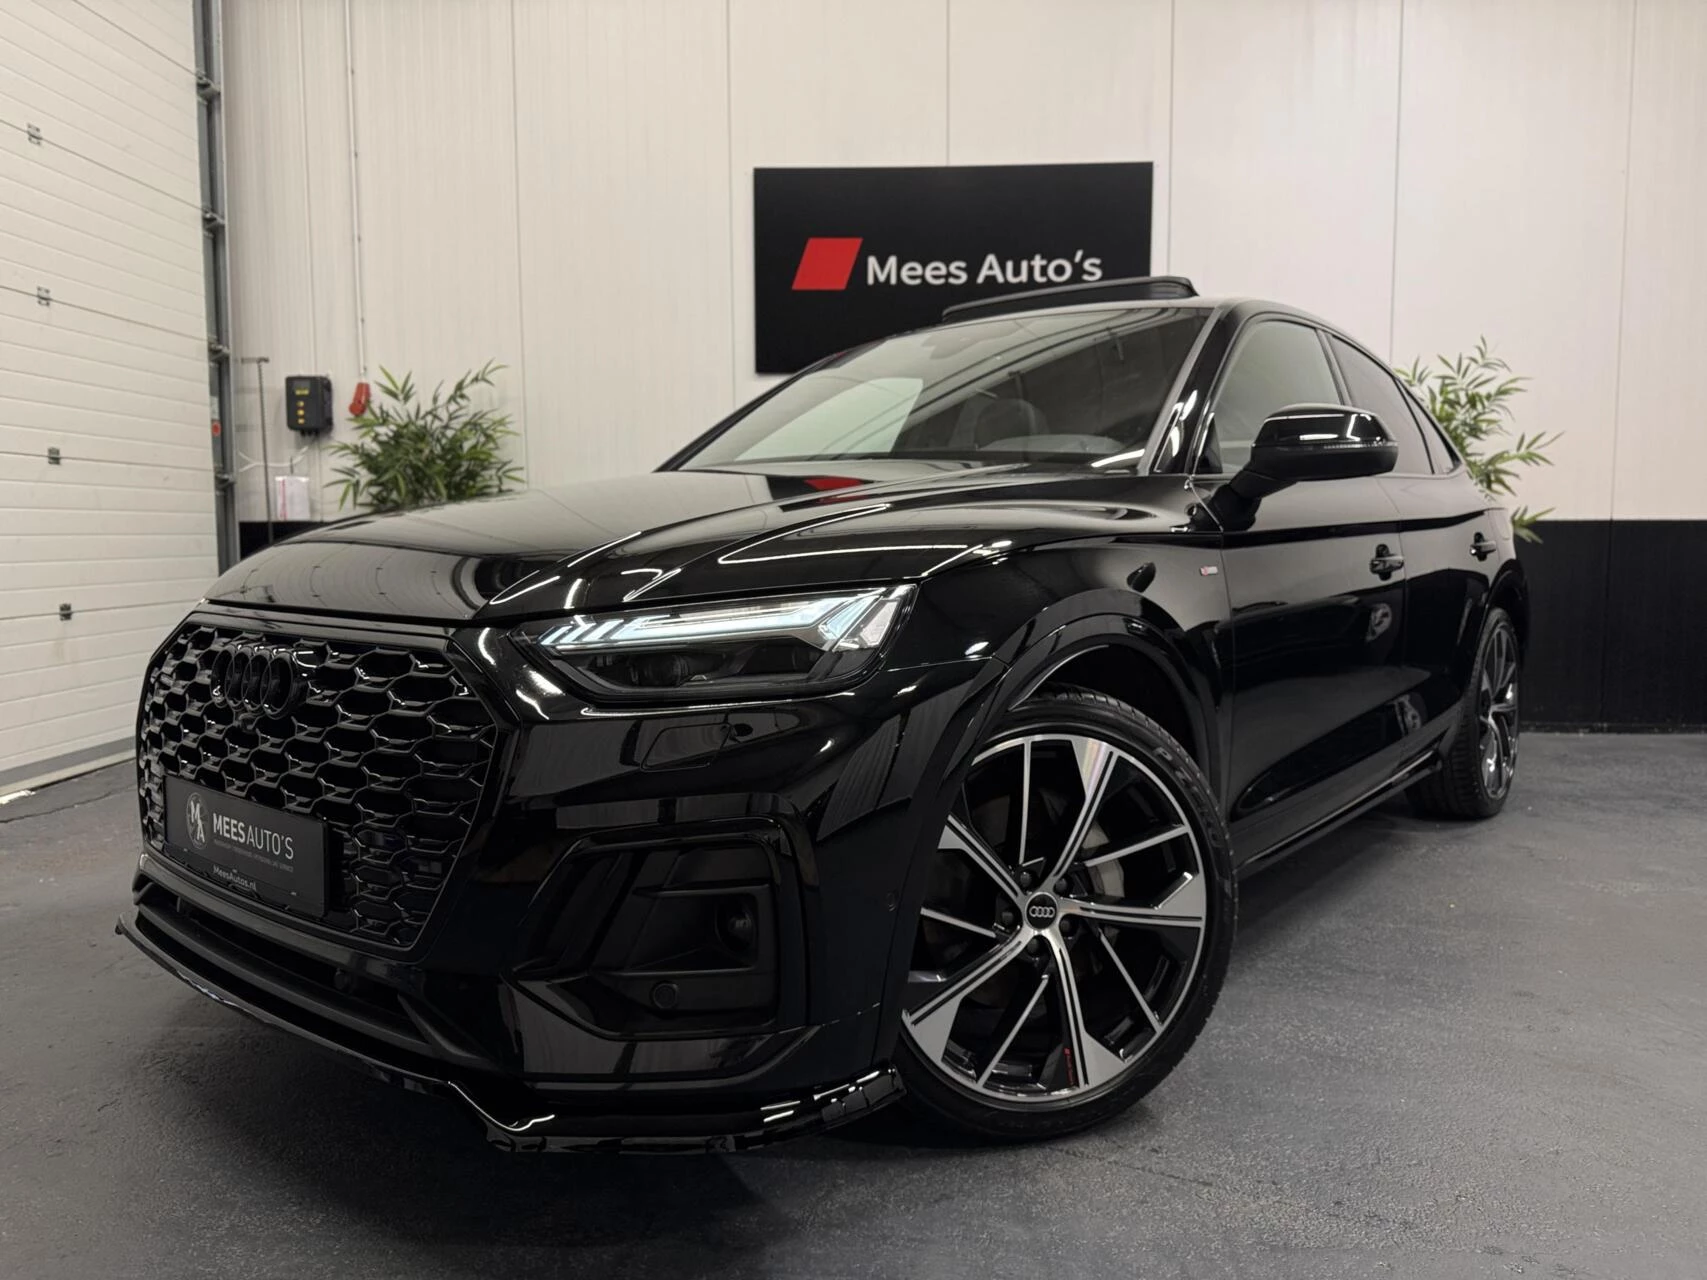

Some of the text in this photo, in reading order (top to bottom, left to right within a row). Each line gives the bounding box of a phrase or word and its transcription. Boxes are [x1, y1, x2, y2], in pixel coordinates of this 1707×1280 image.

[866, 249, 1103, 286] Mees Auto's
[212, 865, 257, 892] MeesAutos.nl
